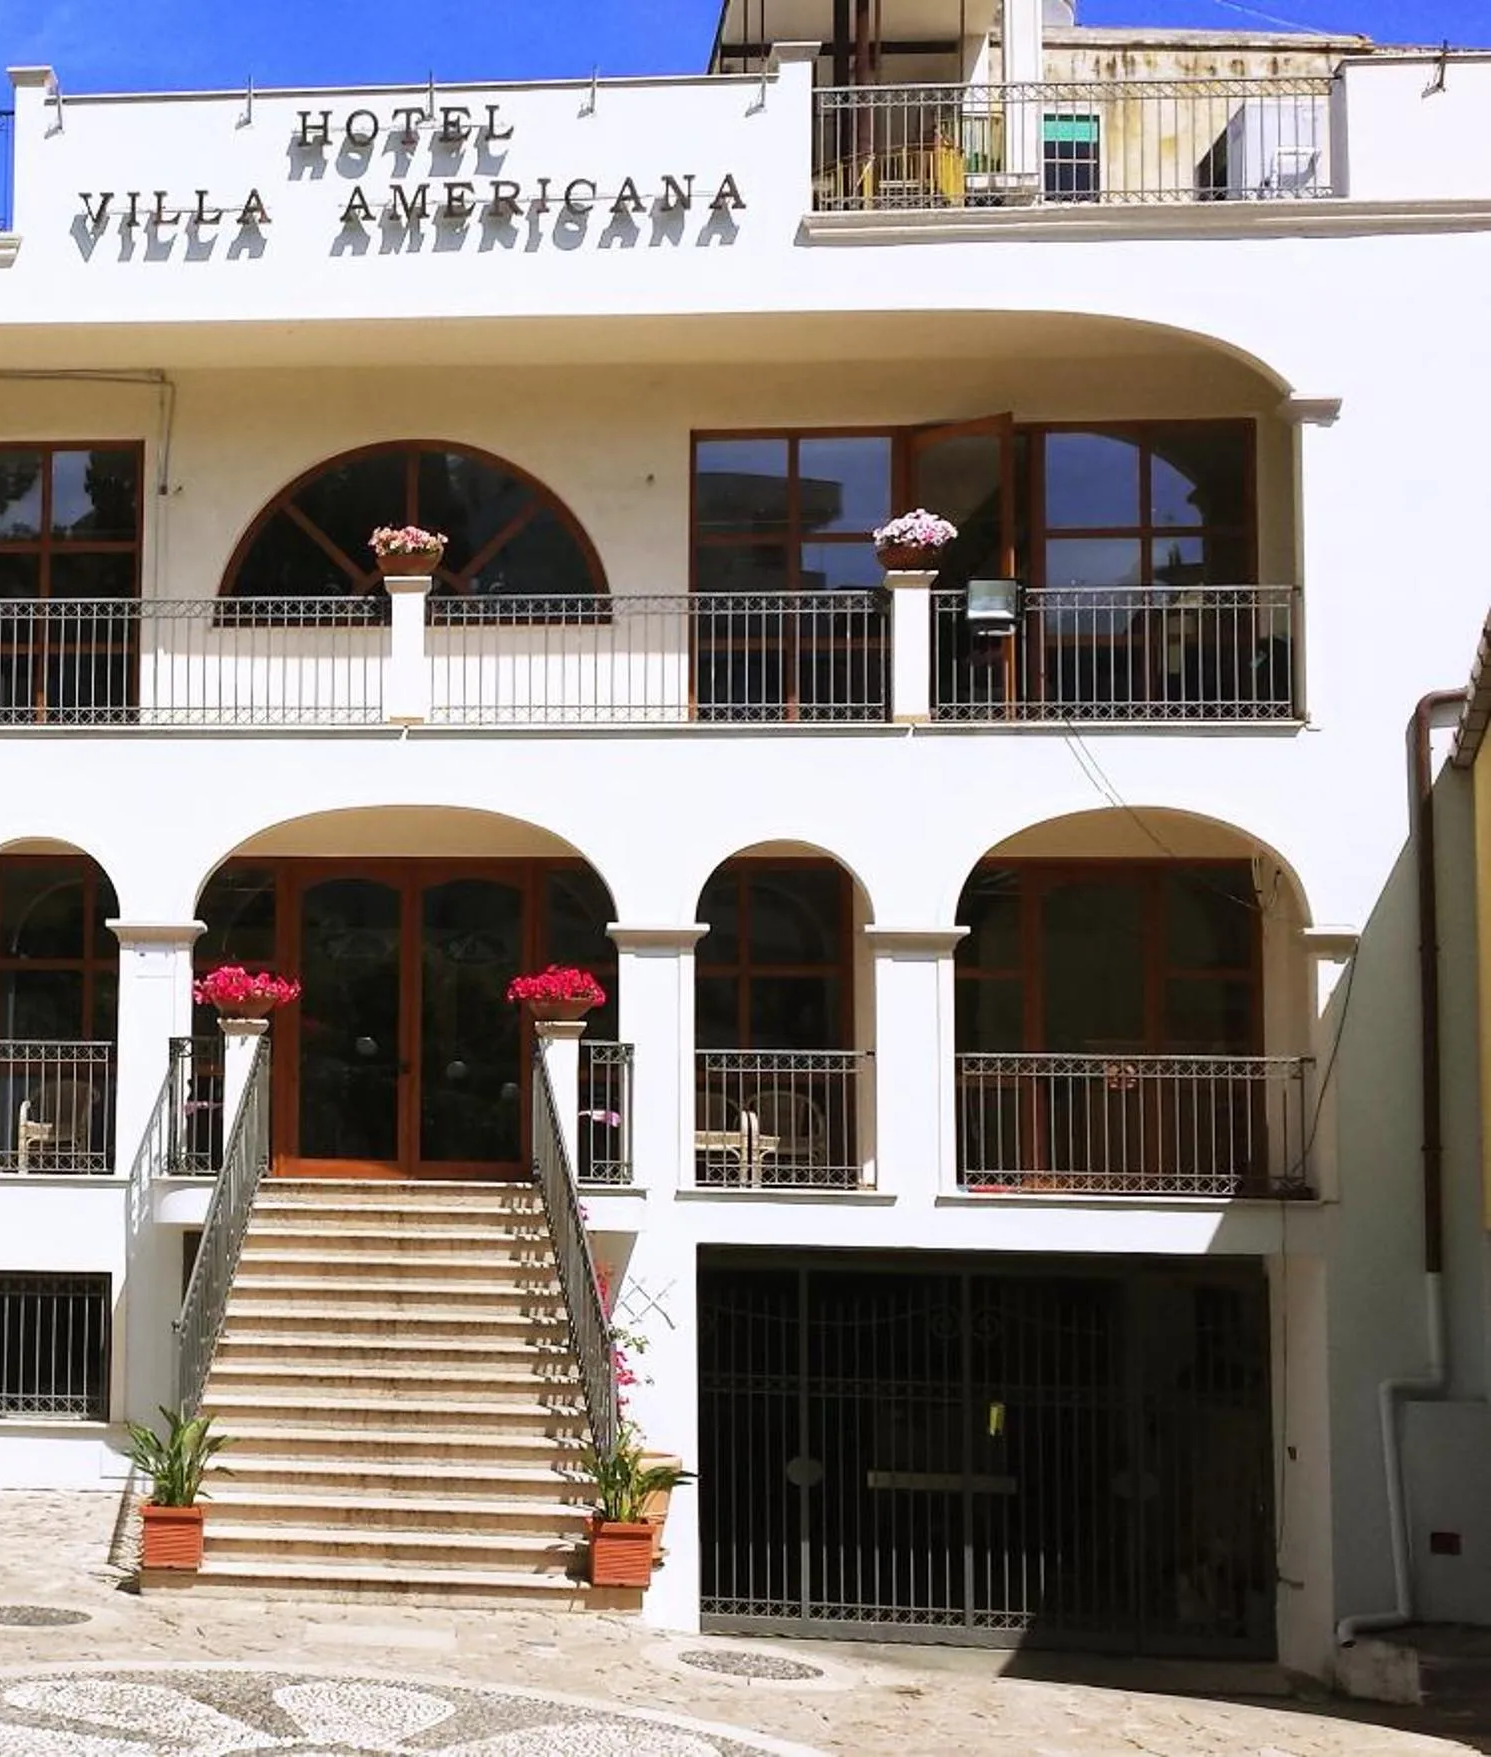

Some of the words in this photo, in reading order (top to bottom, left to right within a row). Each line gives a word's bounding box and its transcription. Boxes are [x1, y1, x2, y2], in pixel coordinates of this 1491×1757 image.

[296, 105, 514, 147] HOTEL
[79, 189, 271, 227] VILLA
[340, 174, 746, 222] AMERICANA
